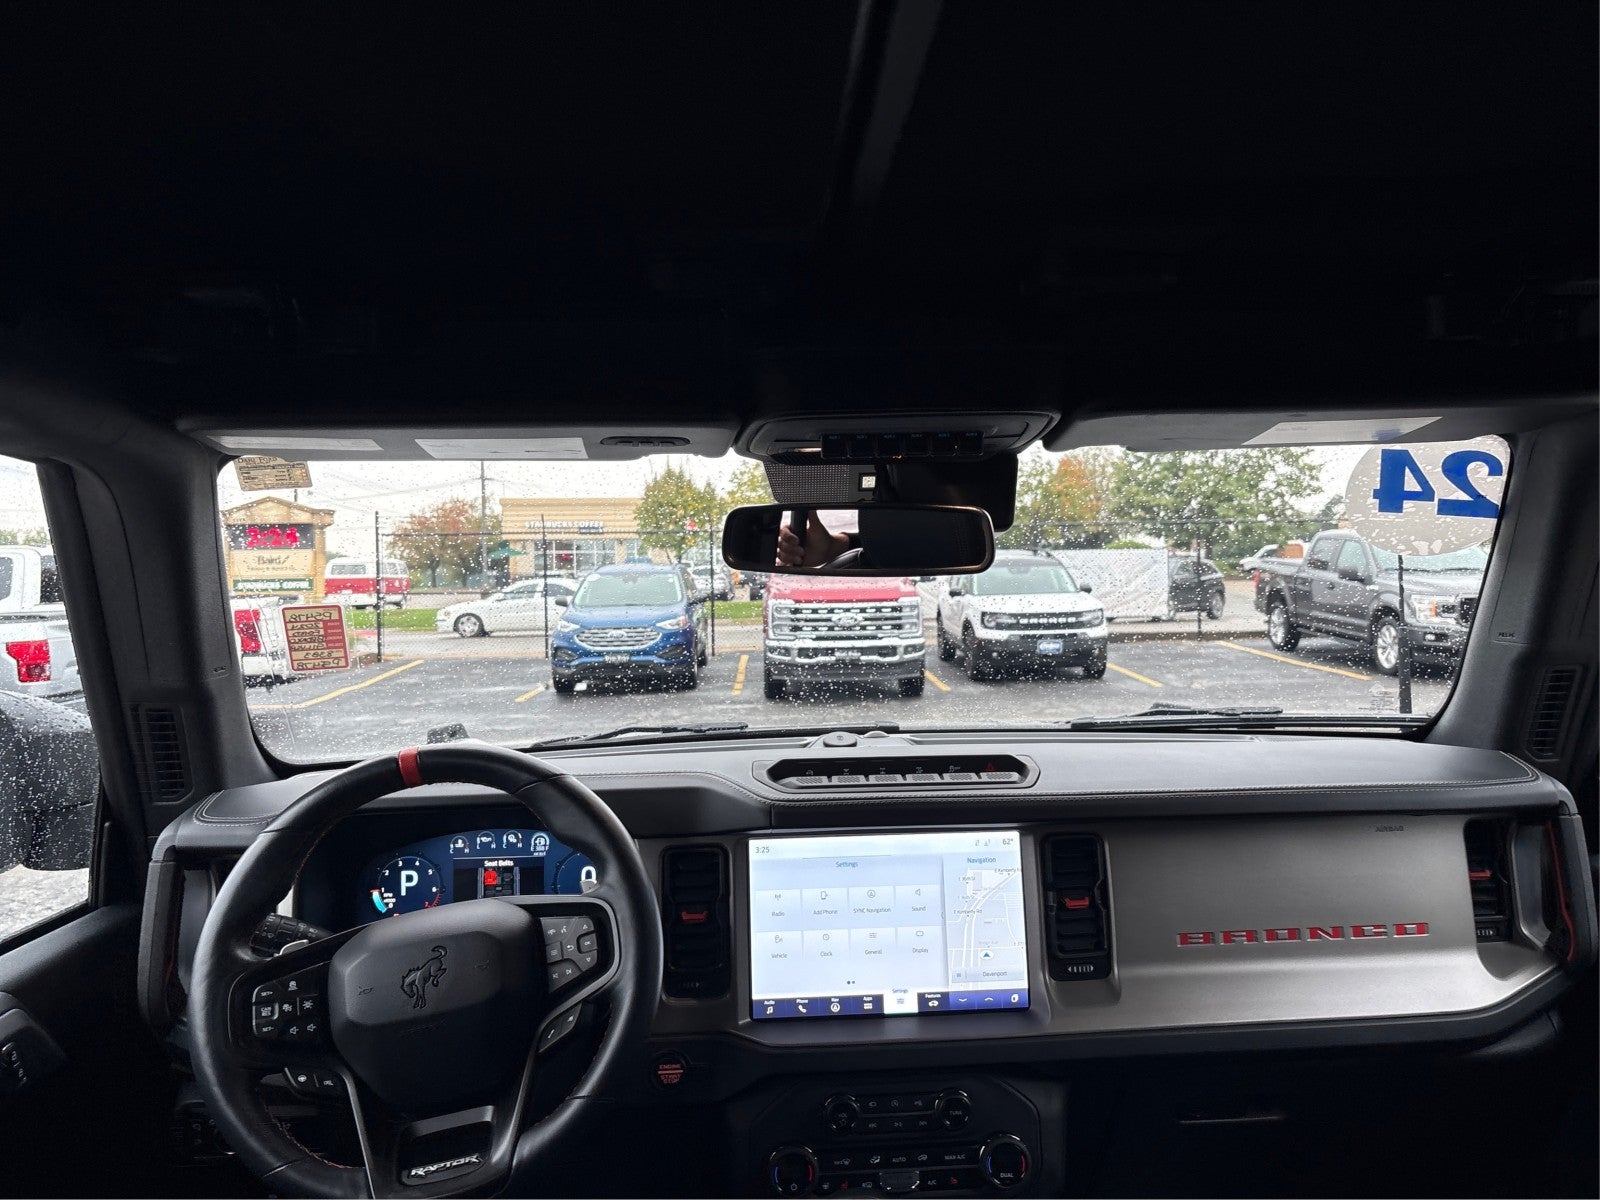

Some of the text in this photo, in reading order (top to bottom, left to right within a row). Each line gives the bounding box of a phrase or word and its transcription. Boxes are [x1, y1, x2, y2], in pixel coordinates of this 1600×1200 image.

[755, 846, 770, 854] 3:25
[835, 860, 859, 869] Settings
[400, 870, 419, 897] P
[1177, 922, 1429, 947] BRONCO
[410, 1153, 480, 1176] RAPTOR
